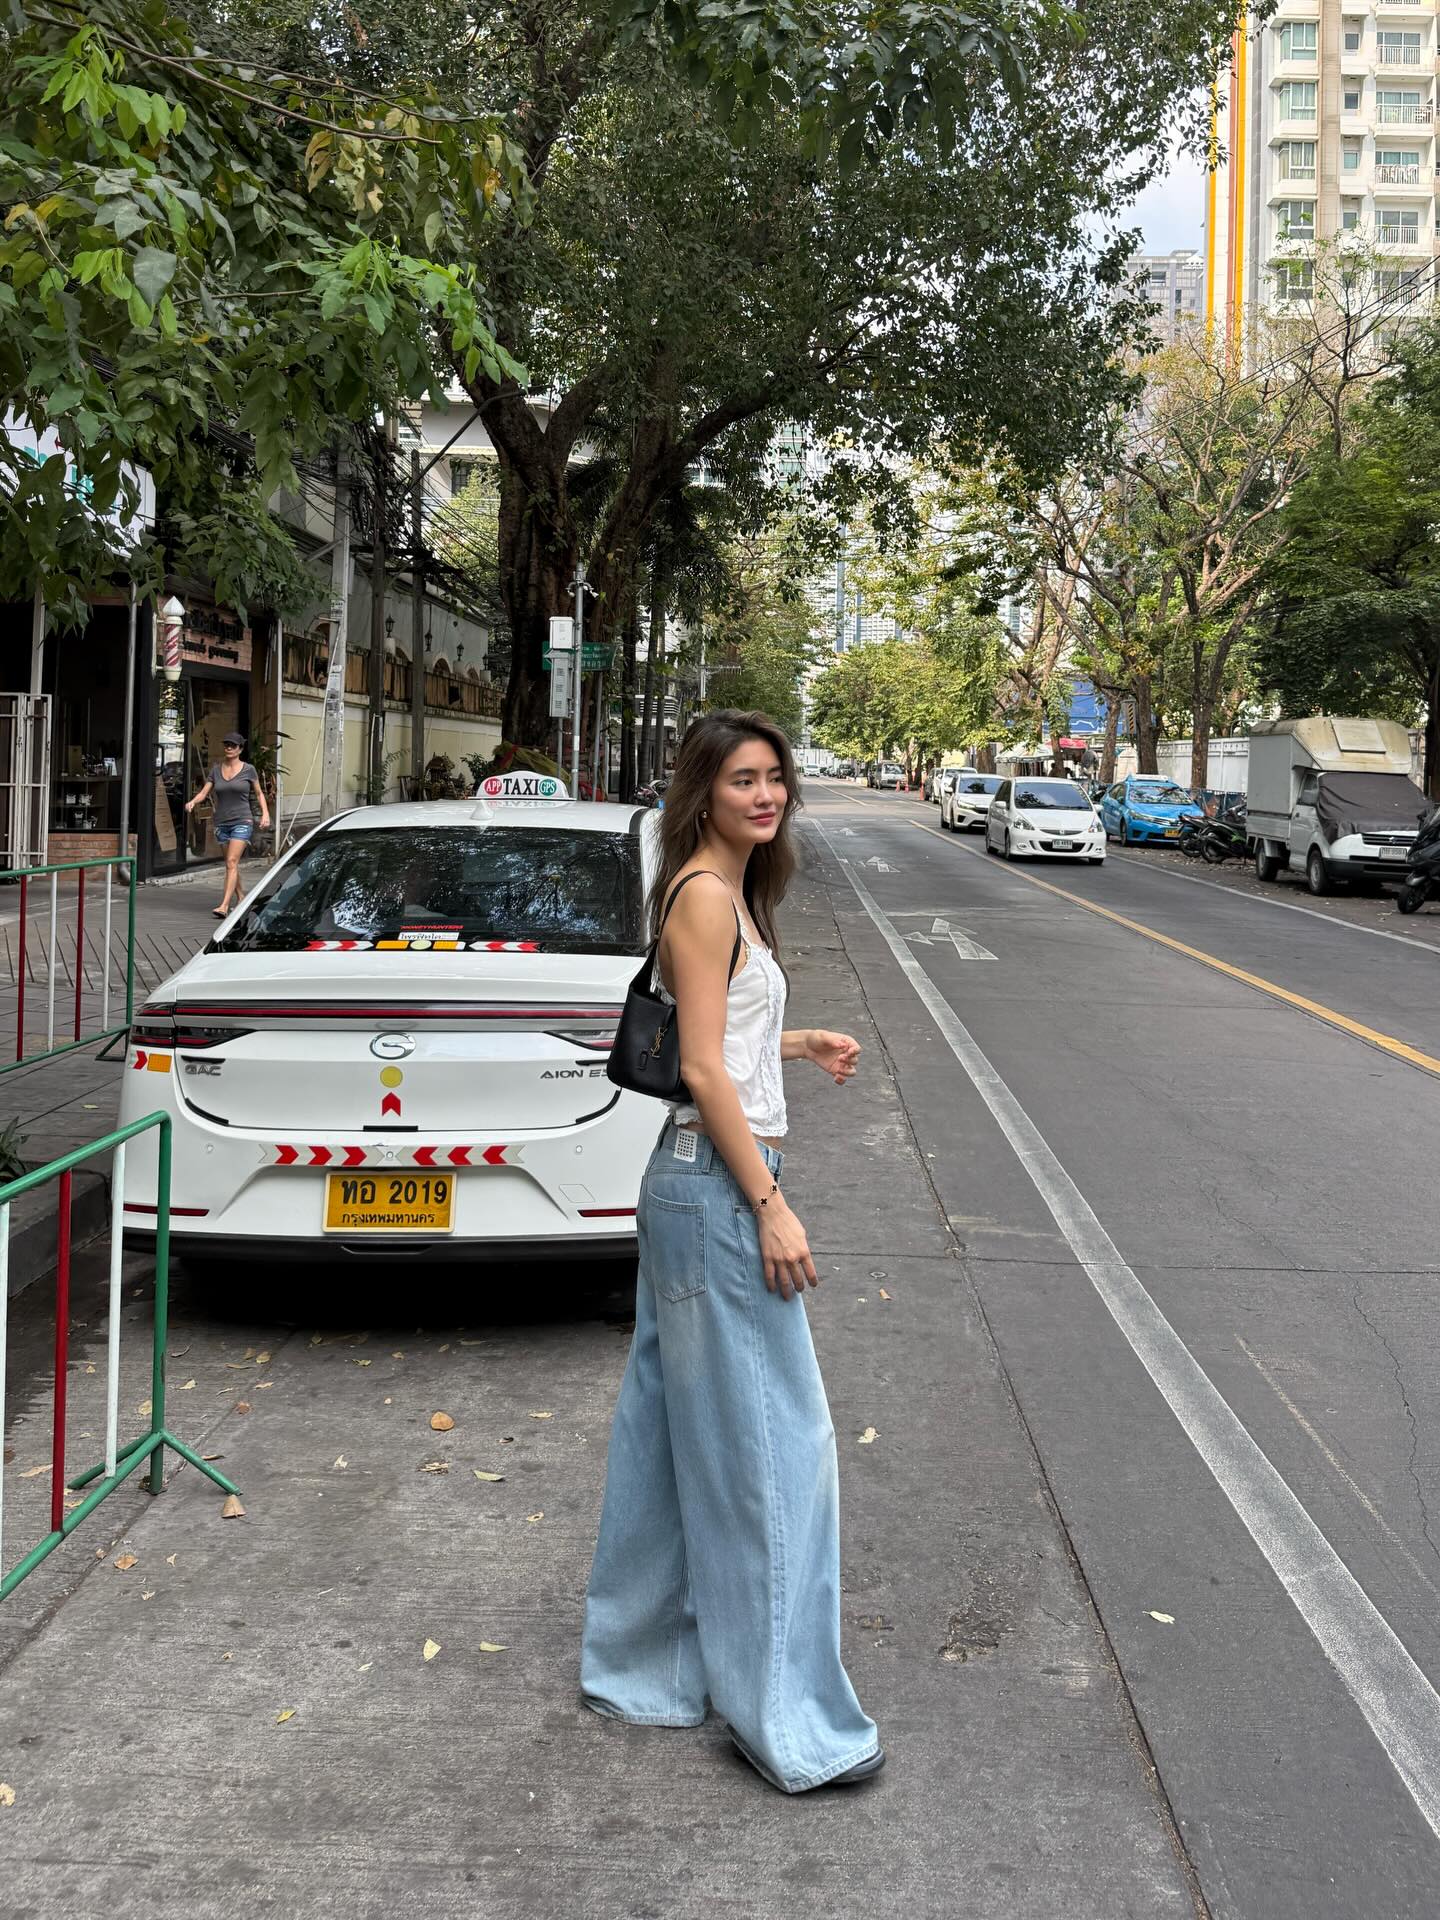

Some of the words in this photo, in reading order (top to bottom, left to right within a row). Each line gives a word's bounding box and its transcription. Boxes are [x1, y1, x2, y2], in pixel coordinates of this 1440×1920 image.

[486, 779, 501, 792] APP
[503, 778, 540, 796] TAXI
[540, 780, 555, 794] GPS
[540, 1070, 584, 1079] AION
[341, 1180, 376, 1205] ทอ
[389, 1180, 448, 1205] 2019
[342, 1212, 436, 1227] กรุงเทพมหานคร
